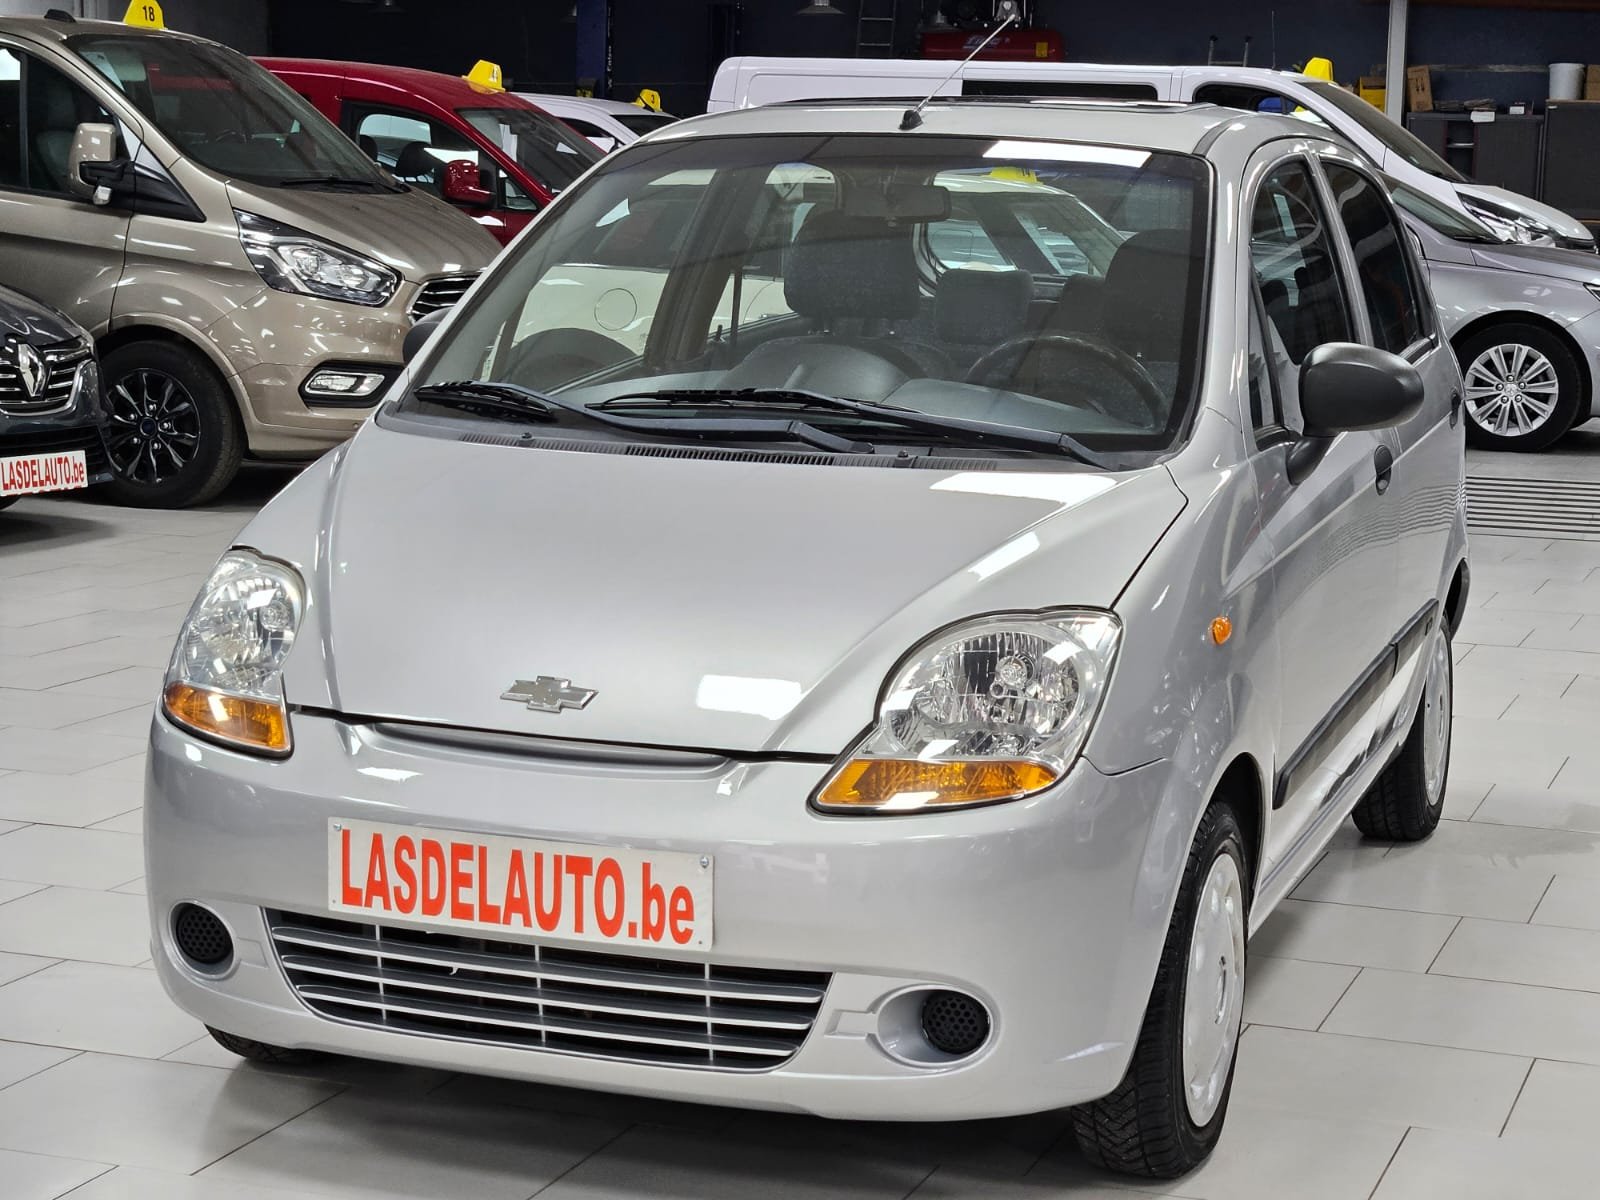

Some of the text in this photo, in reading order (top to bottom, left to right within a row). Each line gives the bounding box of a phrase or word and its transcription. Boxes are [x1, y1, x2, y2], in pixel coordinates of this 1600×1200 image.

[142, 5, 155, 22] 18
[1, 455, 85, 491] LASDELAUTO.be
[341, 828, 695, 946] LASDELAUTO.be
